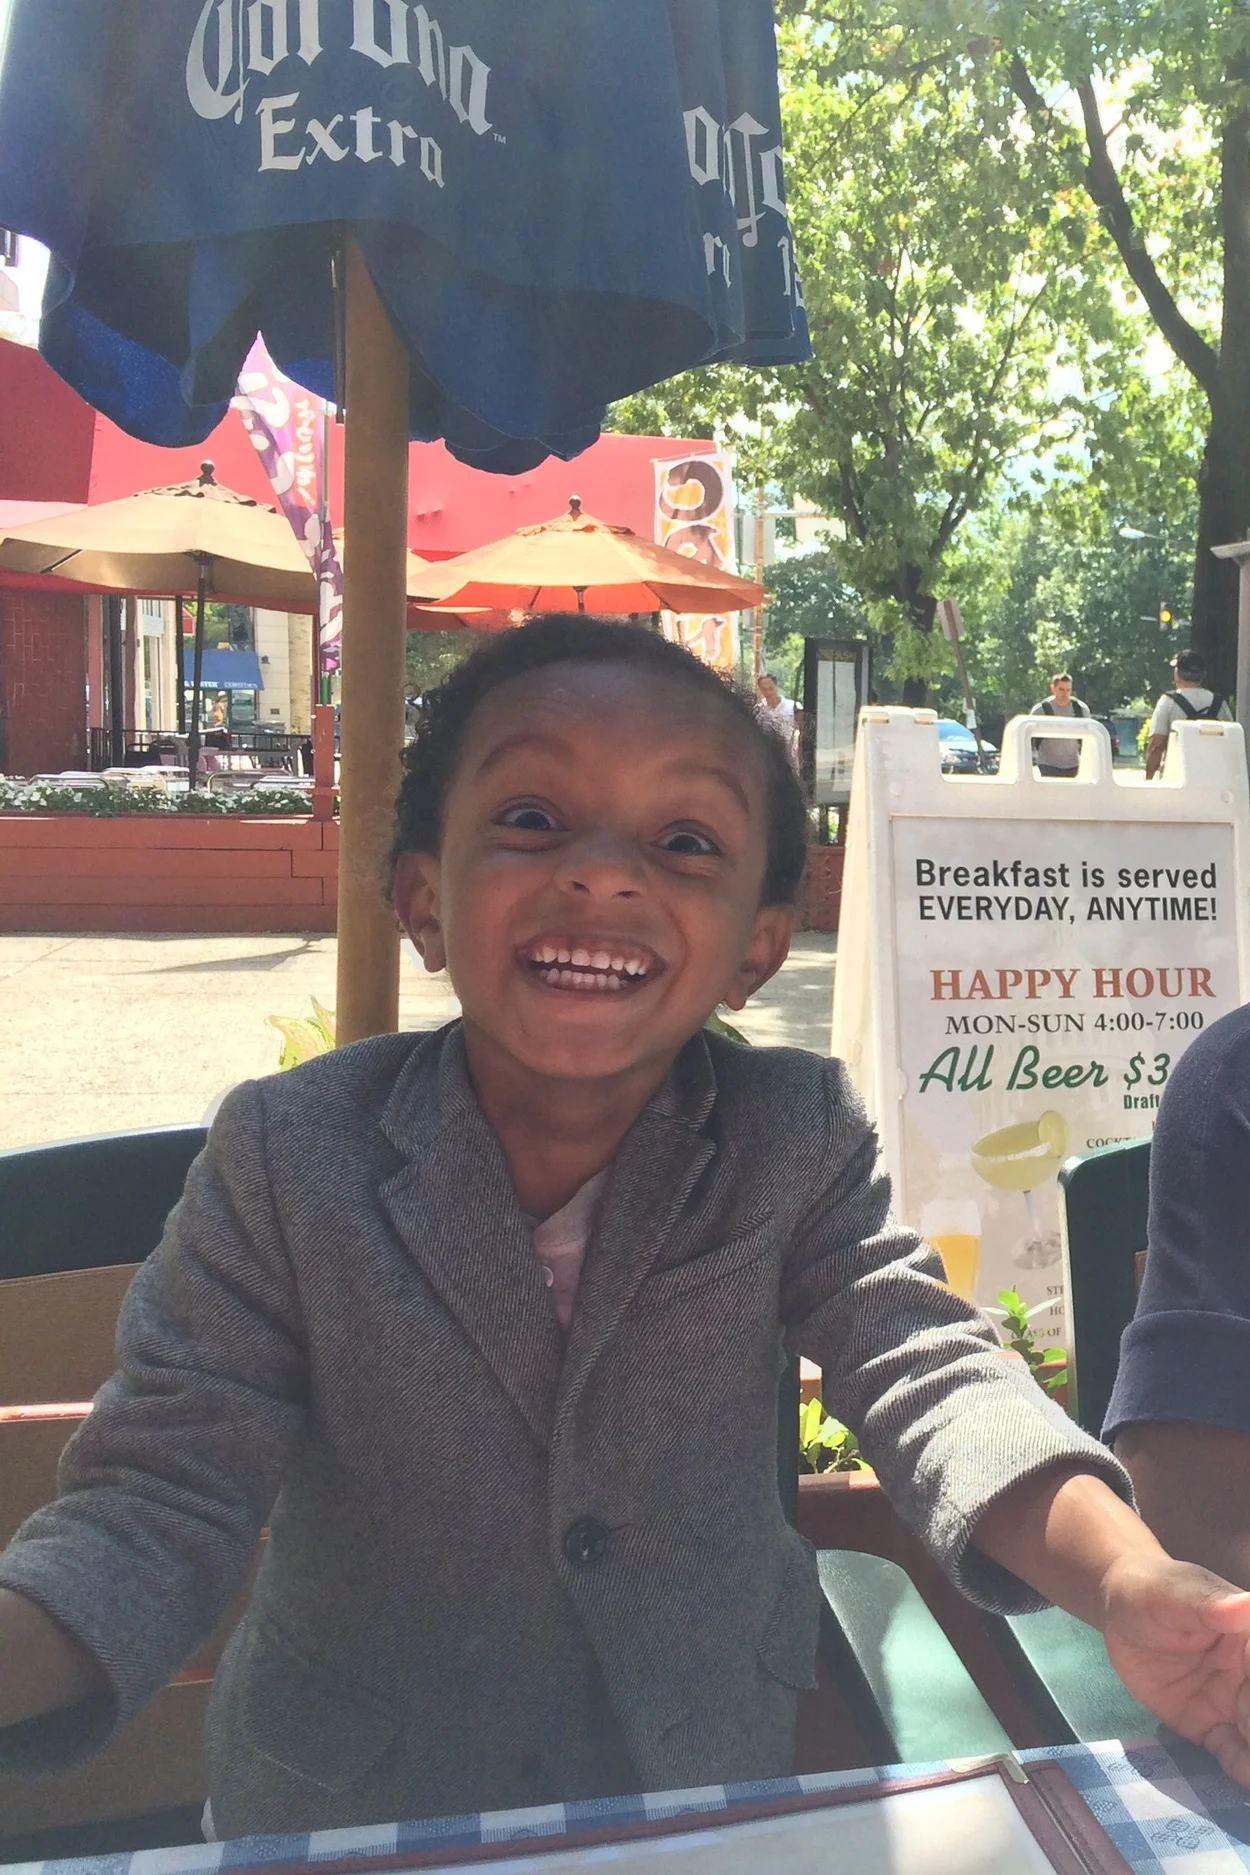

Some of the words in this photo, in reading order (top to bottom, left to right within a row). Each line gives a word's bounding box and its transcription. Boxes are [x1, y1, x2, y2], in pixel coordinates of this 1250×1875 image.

[255, 91, 445, 188] Extra
[916, 858, 1069, 888] Breakfast
[1081, 861, 1104, 888] is
[1118, 862, 1217, 889] served
[919, 895, 1076, 925] EVERYDAY,
[1086, 896, 1217, 921] ANYTIME!
[930, 967, 1081, 1000] HAPPY
[1092, 967, 1217, 998] HOUR
[945, 1012, 1086, 1035] MON-SUN
[1094, 1010, 1204, 1032] 4:00-7:00
[919, 1044, 995, 1093] All
[1006, 1045, 1109, 1091] Beer
[1123, 1093, 1159, 1110] Draft
